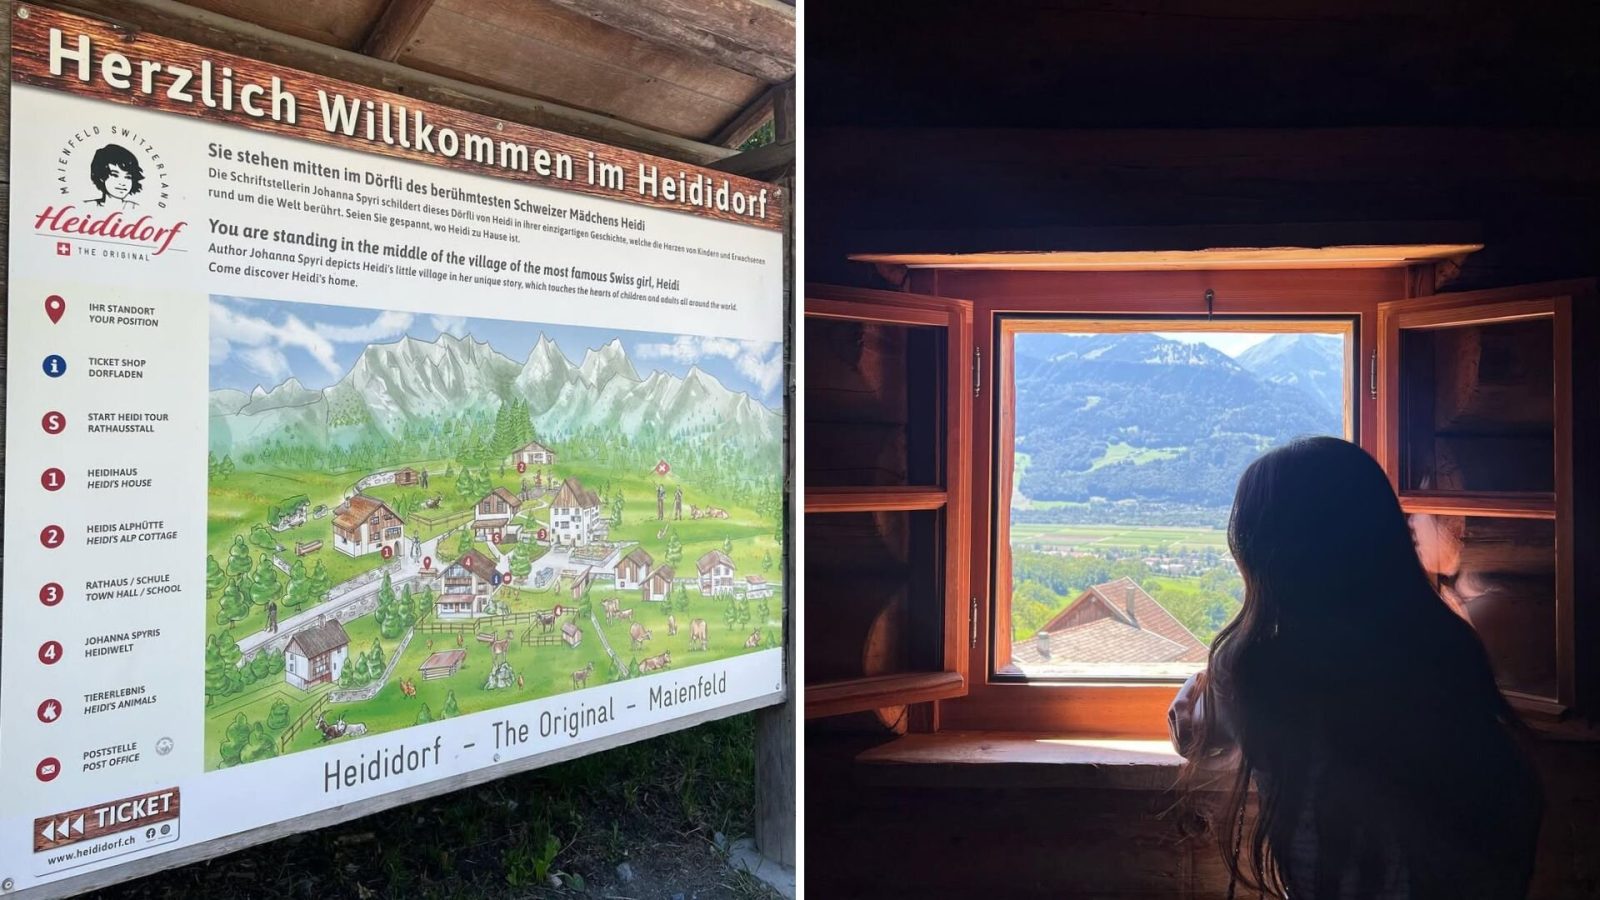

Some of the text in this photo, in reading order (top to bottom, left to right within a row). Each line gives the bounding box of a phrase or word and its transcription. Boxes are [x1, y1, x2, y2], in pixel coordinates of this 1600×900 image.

[48, 28, 767, 218] Herzlich Willkommen im Heididorf
[58, 126, 169, 208] MAIENFELD SWITZERLAND
[208, 143, 645, 231] Sie stehen mitten im Dörfli des berühmtesten Schweizer Mädchens Heidi
[208, 168, 227, 180] Die
[230, 171, 310, 193] Schriftstellerin
[312, 186, 354, 201] Johanna
[356, 193, 379, 206] Spyri
[382, 198, 421, 212] schildert
[423, 204, 449, 216] dieses
[451, 208, 474, 220] Dörfli
[476, 214, 490, 223] von
[492, 216, 513, 226] Heidi
[514, 220, 521, 228] in
[523, 220, 540, 230] ihrer
[542, 225, 589, 238] einzigartigen
[590, 230, 628, 244] Geschichte,
[629, 237, 651, 248] welche
[653, 240, 662, 249] die
[663, 242, 685, 252] Herzen
[720, 252, 730, 260] und
[208, 188, 234, 200] rund
[238, 193, 254, 203] um
[257, 194, 274, 206] die
[277, 197, 301, 210] Welt
[304, 202, 344, 217] berührt.
[346, 209, 372, 221] Seien
[374, 213, 387, 224] Sie
[390, 217, 432, 231] gespannt,
[434, 224, 446, 232] wo
[449, 224, 470, 236] Heidi
[483, 230, 507, 242] Hause
[509, 233, 520, 243] ist.
[34, 205, 188, 255] Heididorf
[78, 247, 149, 262] THE ORIGINAL
[209, 218, 679, 291] You are standing in the middle of the village of the most famous Swiss girl, Heidi
[208, 262, 358, 287] Come discover Heidi's home.
[208, 243, 248, 256] Author
[249, 248, 295, 262] Johanna
[298, 254, 322, 267] Spyri
[325, 257, 360, 270] depicts
[363, 261, 394, 274] Heidi's
[396, 266, 416, 276] little
[419, 268, 446, 282] village
[449, 272, 457, 281] in
[459, 273, 472, 282] her
[474, 276, 501, 287] unique
[503, 279, 524, 289] story,
[525, 280, 547, 291] which
[548, 282, 576, 294] touches
[577, 287, 588, 295] the
[590, 288, 611, 298] hearts
[620, 291, 647, 301] children
[648, 294, 659, 302] and
[711, 301, 719, 309] the
[89, 303, 155, 316] IHR STANDORT
[89, 315, 159, 327] YOUR POSITION
[89, 357, 146, 367] TICKET SHOP
[89, 369, 143, 378] DORFLADEN
[49, 416, 59, 430] S
[88, 413, 169, 421] START HEIDI TOUR
[88, 424, 154, 433] RATHAUSSTALL
[49, 472, 58, 486] 1
[88, 468, 138, 477] HEIDIHAUS
[87, 478, 152, 489] HEIDI'S HOUSE
[87, 520, 164, 533] HEIDIS ALPHÜTTE
[48, 530, 58, 544] 2
[86, 531, 178, 545] HEIDI'S ALP COTTAGE
[86, 578, 128, 589] RATHAUS
[136, 574, 170, 585] SCHULE
[46, 587, 57, 601] 3
[86, 591, 114, 601] TOWN
[116, 589, 138, 598] HALL
[147, 584, 181, 596] SCHOOL
[85, 629, 160, 646] JOHANNA SPYRIS
[45, 645, 56, 659] 4
[85, 643, 134, 657] HEIDIWELT
[84, 686, 146, 702] TIERERLEBNIS
[84, 695, 157, 715] HEIDI'S ANIMALS
[324, 736, 442, 793] Heididorf
[492, 720, 528, 749] The
[539, 702, 615, 739] Original
[649, 671, 727, 712] Maienfeld
[83, 742, 137, 760] POSTSTELLE
[83, 753, 140, 772] POST OFFICE
[94, 792, 174, 828] TICKET
[47, 836, 135, 865] www.heididorf.ch
